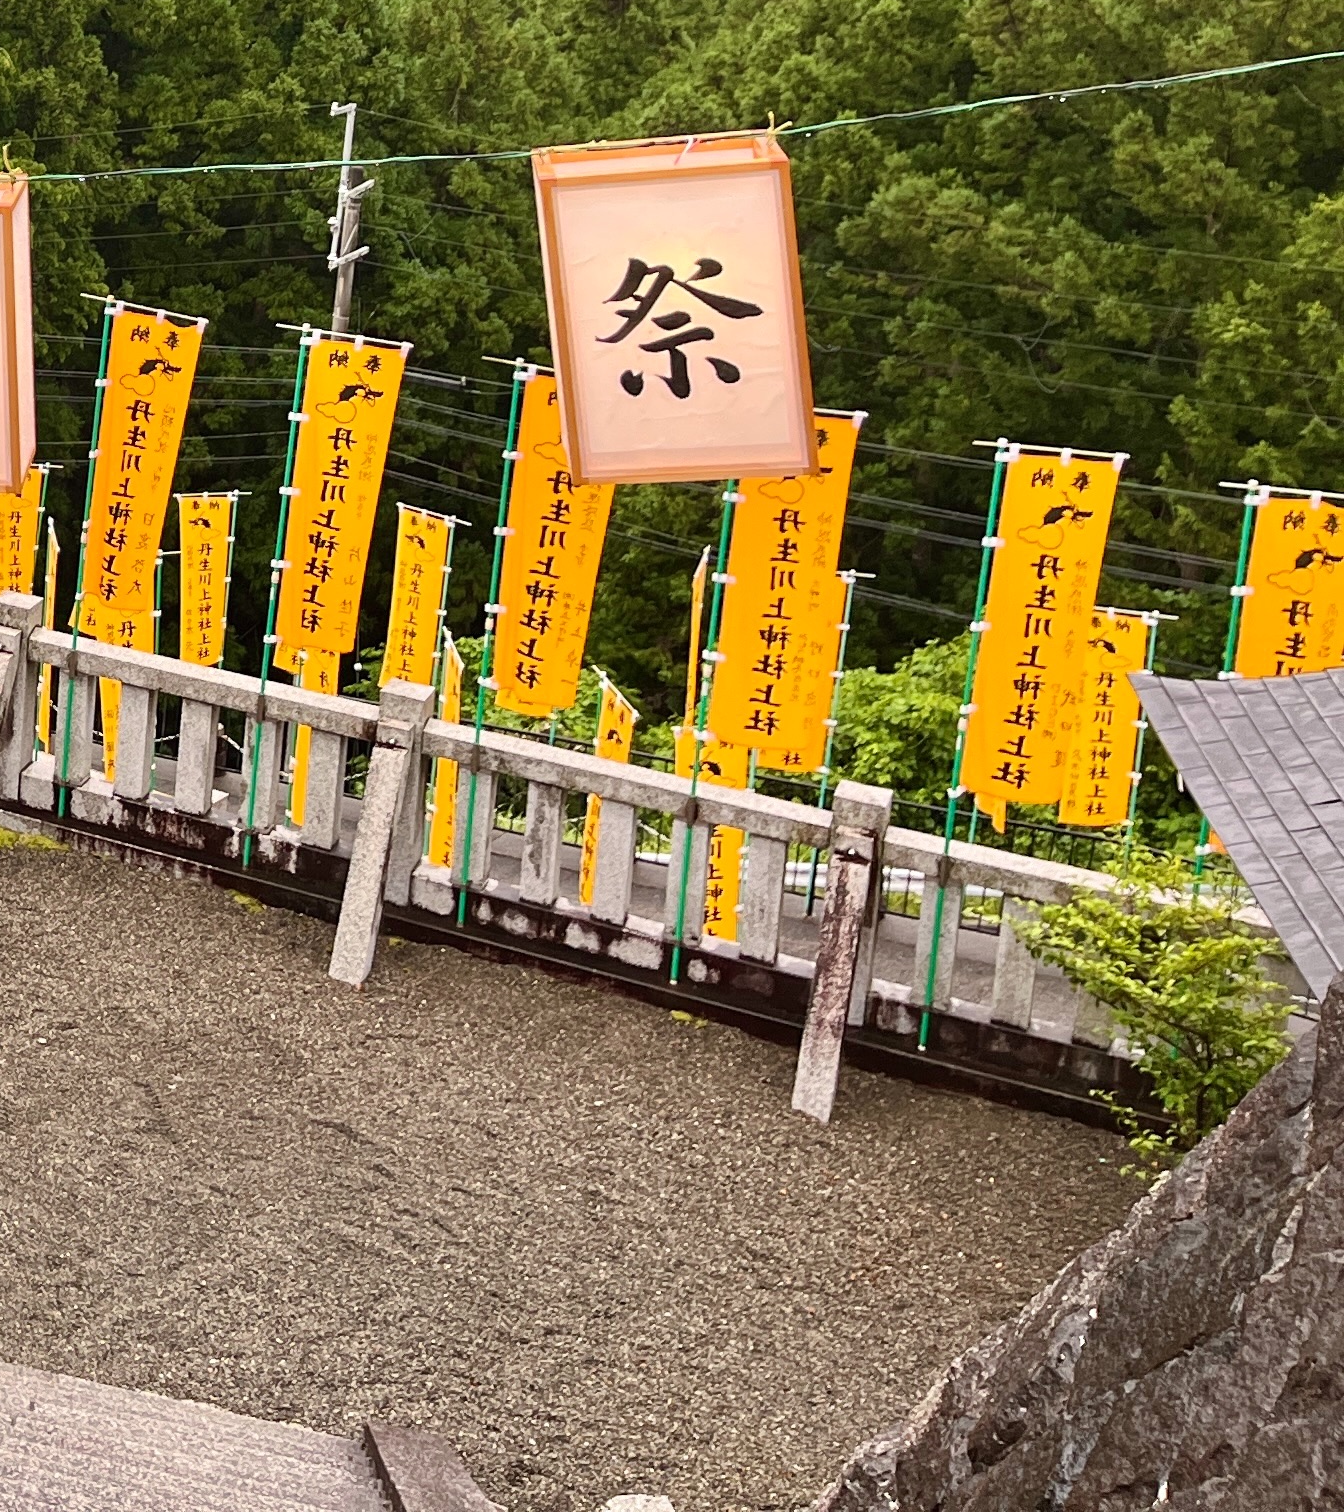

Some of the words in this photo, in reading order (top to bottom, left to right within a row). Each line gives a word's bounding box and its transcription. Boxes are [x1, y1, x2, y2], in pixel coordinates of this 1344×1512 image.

[597, 259, 762, 399] 祭
[197, 543, 213, 660] 丹生川上神社上社
[1086, 672, 1115, 816] 丹生川上神社上社
